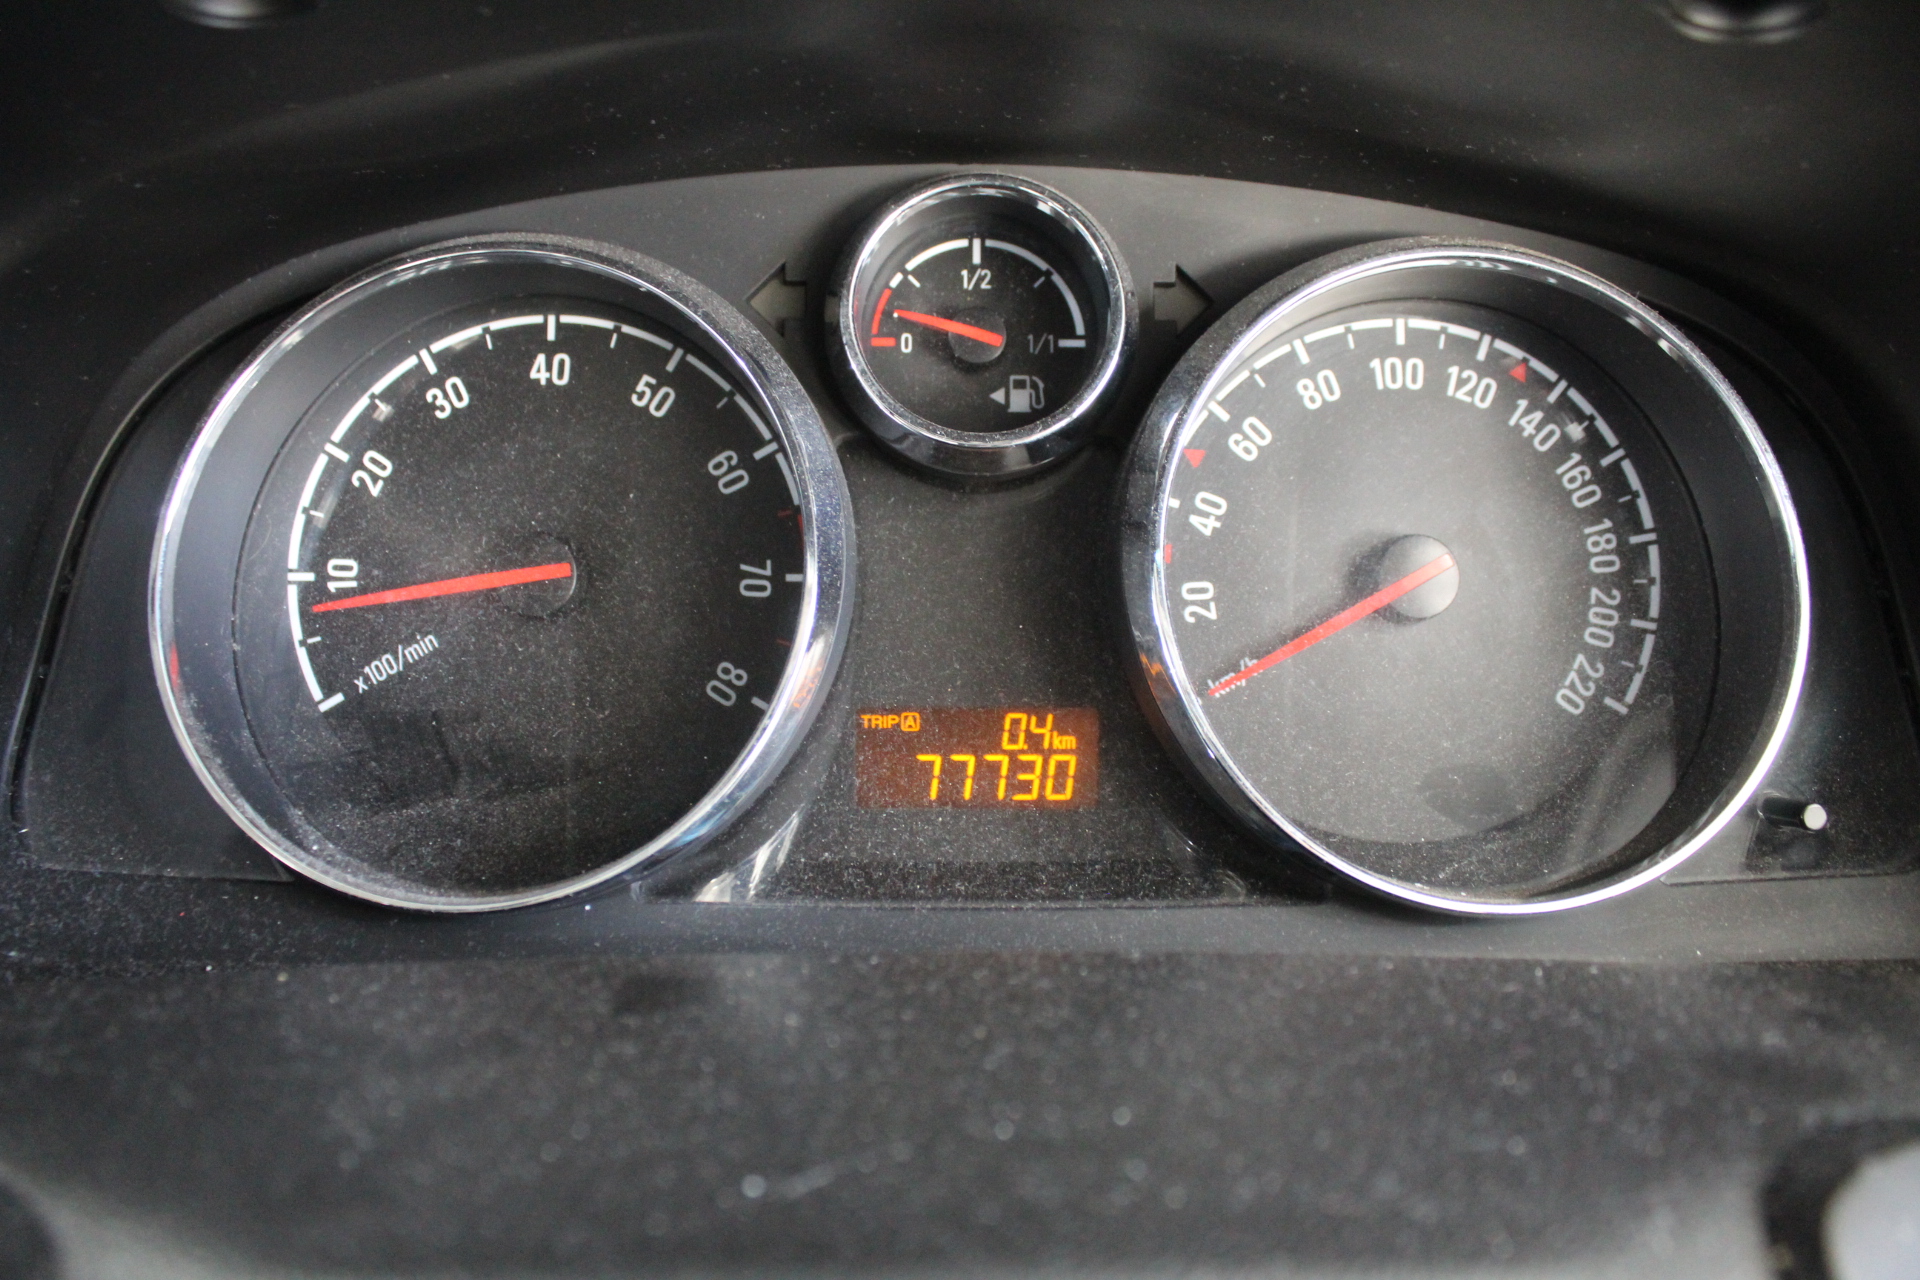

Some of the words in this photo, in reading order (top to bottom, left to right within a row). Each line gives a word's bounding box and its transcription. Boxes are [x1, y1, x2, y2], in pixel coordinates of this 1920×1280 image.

[961, 268, 992, 291] 1/2
[900, 332, 913, 354] 0
[1027, 333, 1054, 355] 1/1
[529, 352, 571, 386] 40
[1296, 369, 1342, 410] 80
[1369, 356, 1425, 391] 100
[1446, 365, 1498, 409] 120
[425, 375, 470, 420] 30
[630, 373, 676, 418] 50
[1227, 416, 1273, 462] 60
[1507, 399, 1561, 453] 140
[351, 450, 393, 498] 20
[707, 450, 749, 495] 60
[1555, 452, 1603, 509] 160
[1188, 491, 1228, 537] 40
[1583, 517, 1621, 574] 180
[326, 558, 359, 593] 10
[739, 559, 772, 598] 70
[1181, 580, 1218, 624] 20
[1583, 586, 1622, 649] 200
[353, 633, 440, 694] x100/min
[705, 661, 748, 707] 80
[1555, 652, 1605, 715] 220
[860, 714, 900, 729] TRIP
[1001, 712, 1054, 751] 0.4
[1052, 731, 1077, 750] km
[916, 753, 1077, 801] 77730
